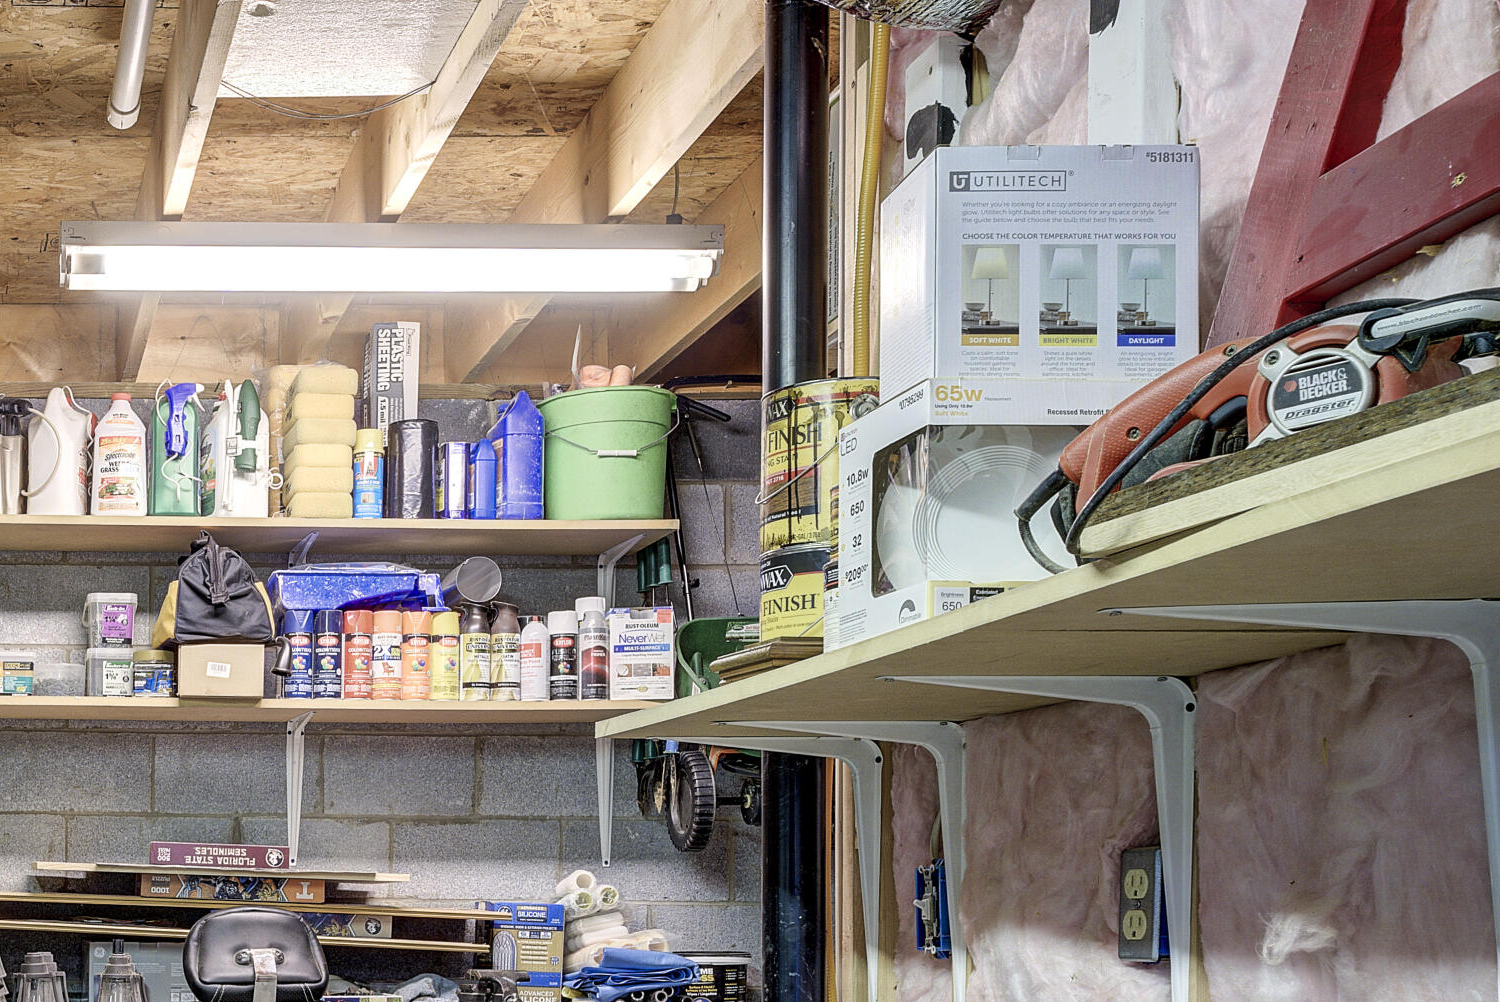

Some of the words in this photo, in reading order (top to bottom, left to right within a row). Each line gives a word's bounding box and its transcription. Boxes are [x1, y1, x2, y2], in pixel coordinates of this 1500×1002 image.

[1146, 152, 1194, 163] #5181311
[974, 175, 1062, 187] UTILITECH
[962, 232, 994, 240] CHOOSE
[996, 232, 1010, 240] THE
[1011, 232, 1038, 240] COLOR
[1040, 232, 1092, 240] TEMPERATURE
[1094, 232, 1113, 240] THAT
[1114, 232, 1142, 240] WORKS
[1143, 232, 1158, 240] FOR
[1160, 232, 1177, 240] YOU
[378, 328, 391, 392] SHEETING
[391, 328, 405, 382] PLASTIC
[1298, 368, 1348, 390] BLACK&
[935, 385, 983, 402] 65w
[1299, 379, 1348, 401] DECKER
[1284, 398, 1354, 421] Dragster
[768, 422, 821, 453] FINISH
[840, 437, 858, 457] LED
[846, 468, 869, 487] 10.8w
[850, 500, 865, 516] 650
[852, 534, 862, 548] 32
[763, 594, 817, 617] FINISH
[942, 601, 962, 611] 650
[619, 633, 666, 643] NeverWet
[185, 855, 214, 864] STATE
[195, 847, 247, 856] SEMINOLES
[217, 857, 256, 866] FLORIDA
[150, 886, 170, 894] 1000
